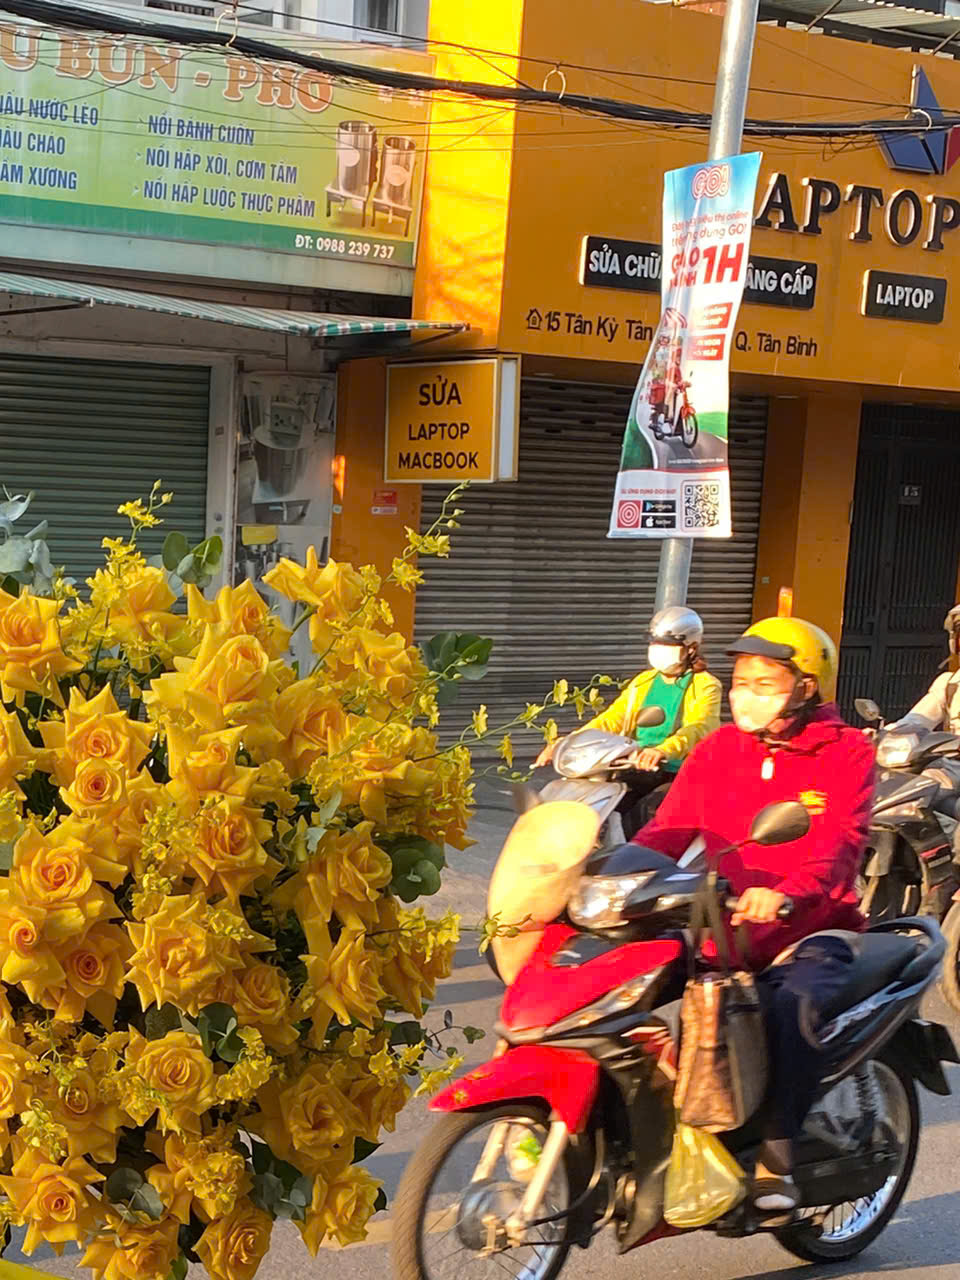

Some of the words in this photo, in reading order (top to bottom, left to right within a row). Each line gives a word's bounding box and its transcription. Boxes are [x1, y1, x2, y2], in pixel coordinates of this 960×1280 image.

[28, 166, 77, 190] XƯƠNG
[236, 159, 265, 179] CƠM
[753, 172, 960, 250] APTOP
[295, 234, 313, 249] ĐT:
[316, 237, 345, 254] 0988
[348, 241, 371, 256] 239
[373, 244, 395, 259] 737
[589, 243, 620, 275] SỬA
[624, 251, 662, 279] CHỮ
[744, 262, 778, 292] ÂNG
[780, 265, 813, 295] CẤP
[703, 242, 744, 284] 1H
[876, 283, 934, 309] LAPTOP
[545, 311, 561, 332] 15
[565, 312, 593, 335] Tân
[596, 316, 619, 343] Kỳ
[625, 319, 653, 342] Tân
[735, 331, 751, 352] Q.
[757, 332, 781, 354] Tân
[786, 334, 817, 357] Bình
[419, 375, 462, 406] SỬA
[408, 422, 470, 440] LAPTOP
[398, 451, 479, 469] MACBOOK
